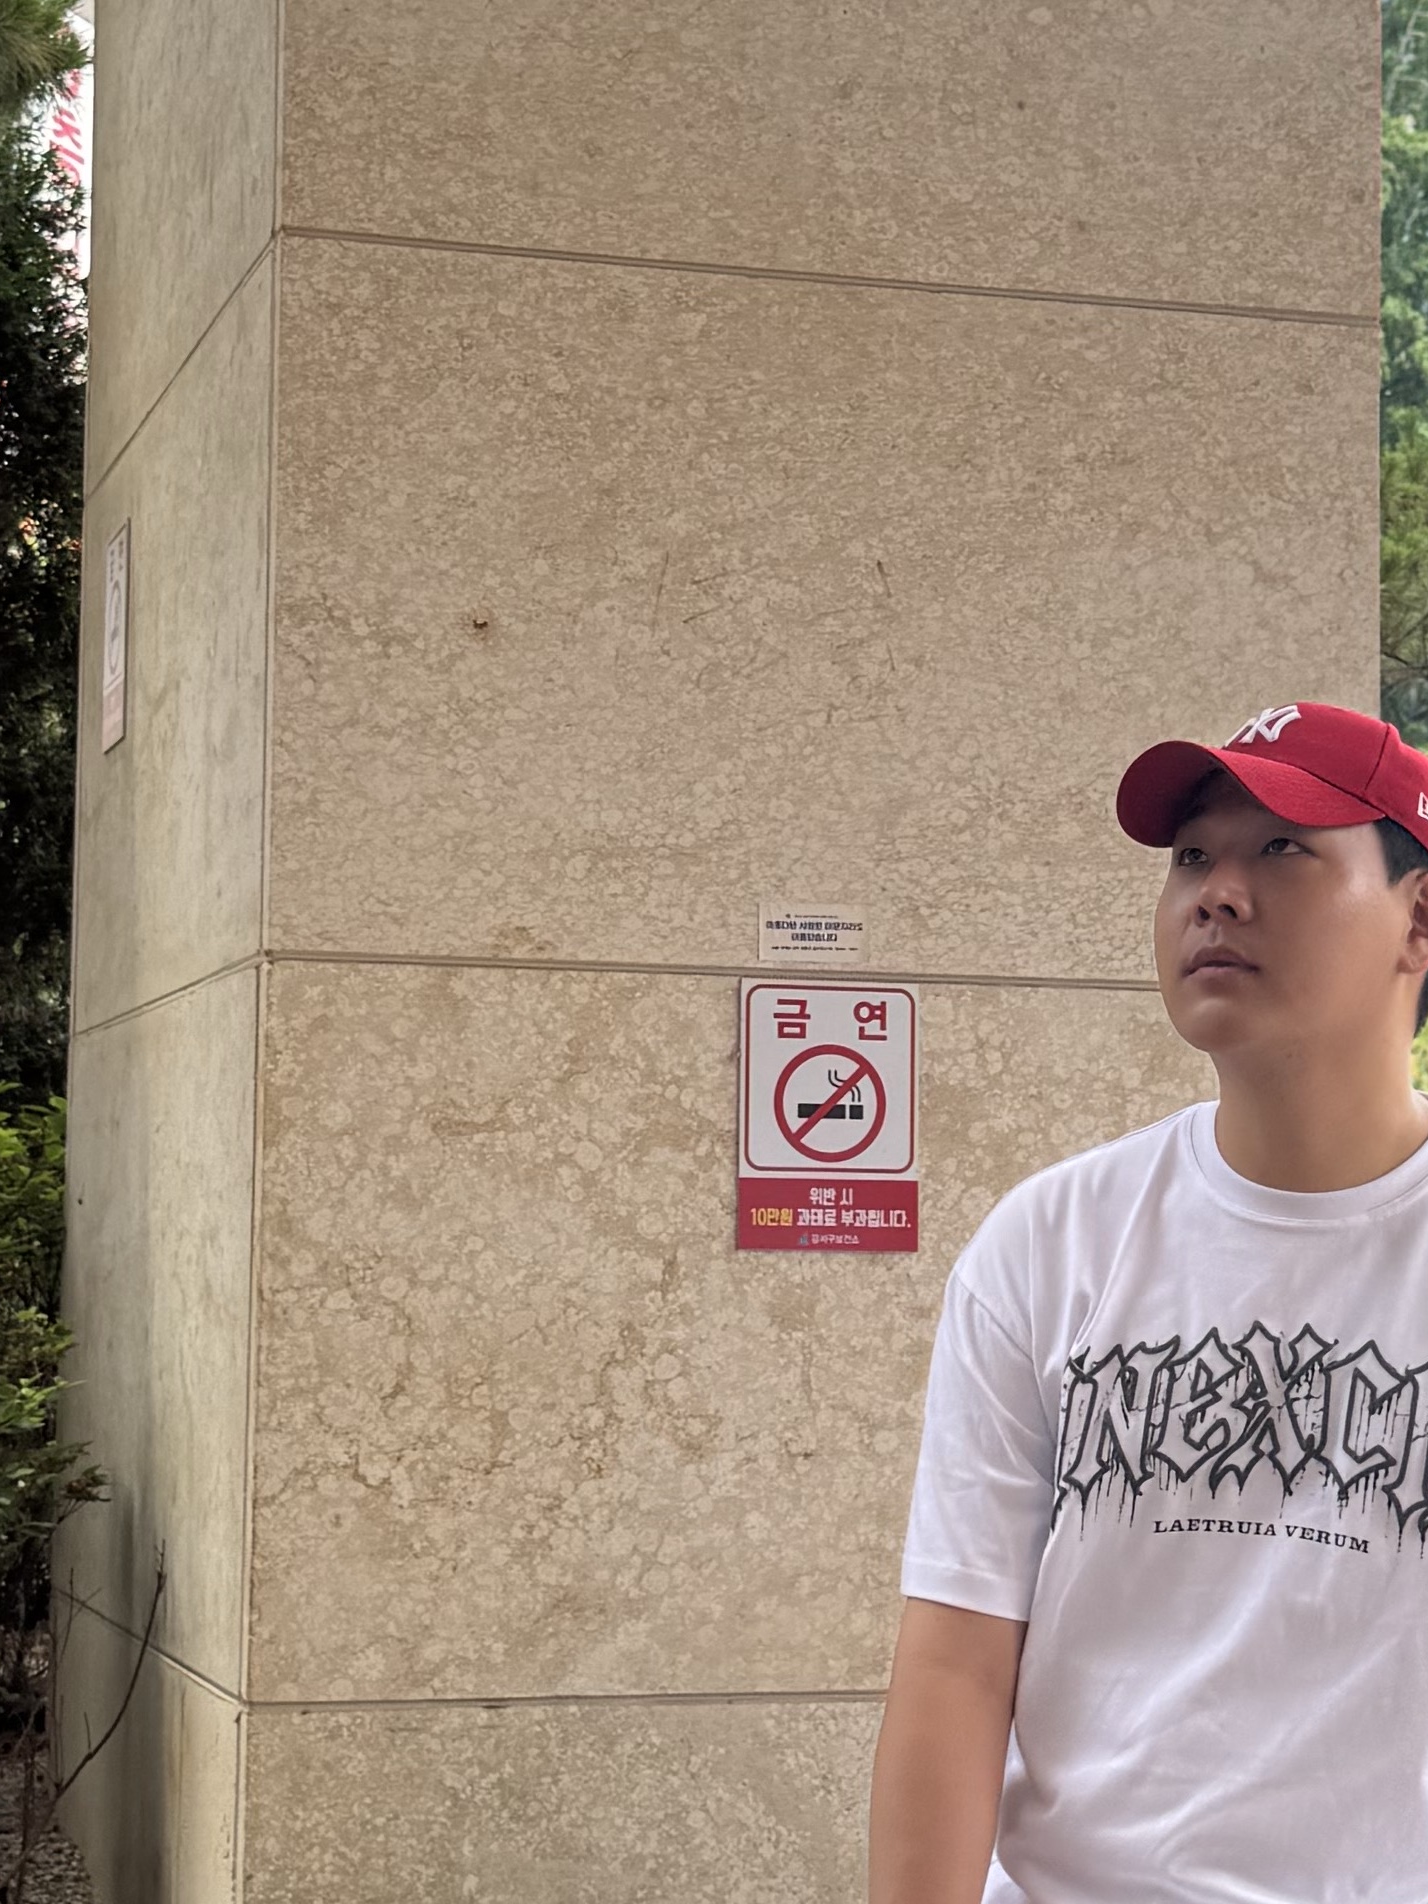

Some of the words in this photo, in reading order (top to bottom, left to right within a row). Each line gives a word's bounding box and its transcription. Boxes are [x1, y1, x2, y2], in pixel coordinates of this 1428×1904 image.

[809, 1187, 837, 1206] 위반
[839, 1188, 854, 1206] 시
[750, 1208, 793, 1227] 10만원
[796, 1208, 838, 1227] 과태료
[1153, 1518, 1277, 1537] LAETRUIA
[1284, 1524, 1371, 1554] VERUM
